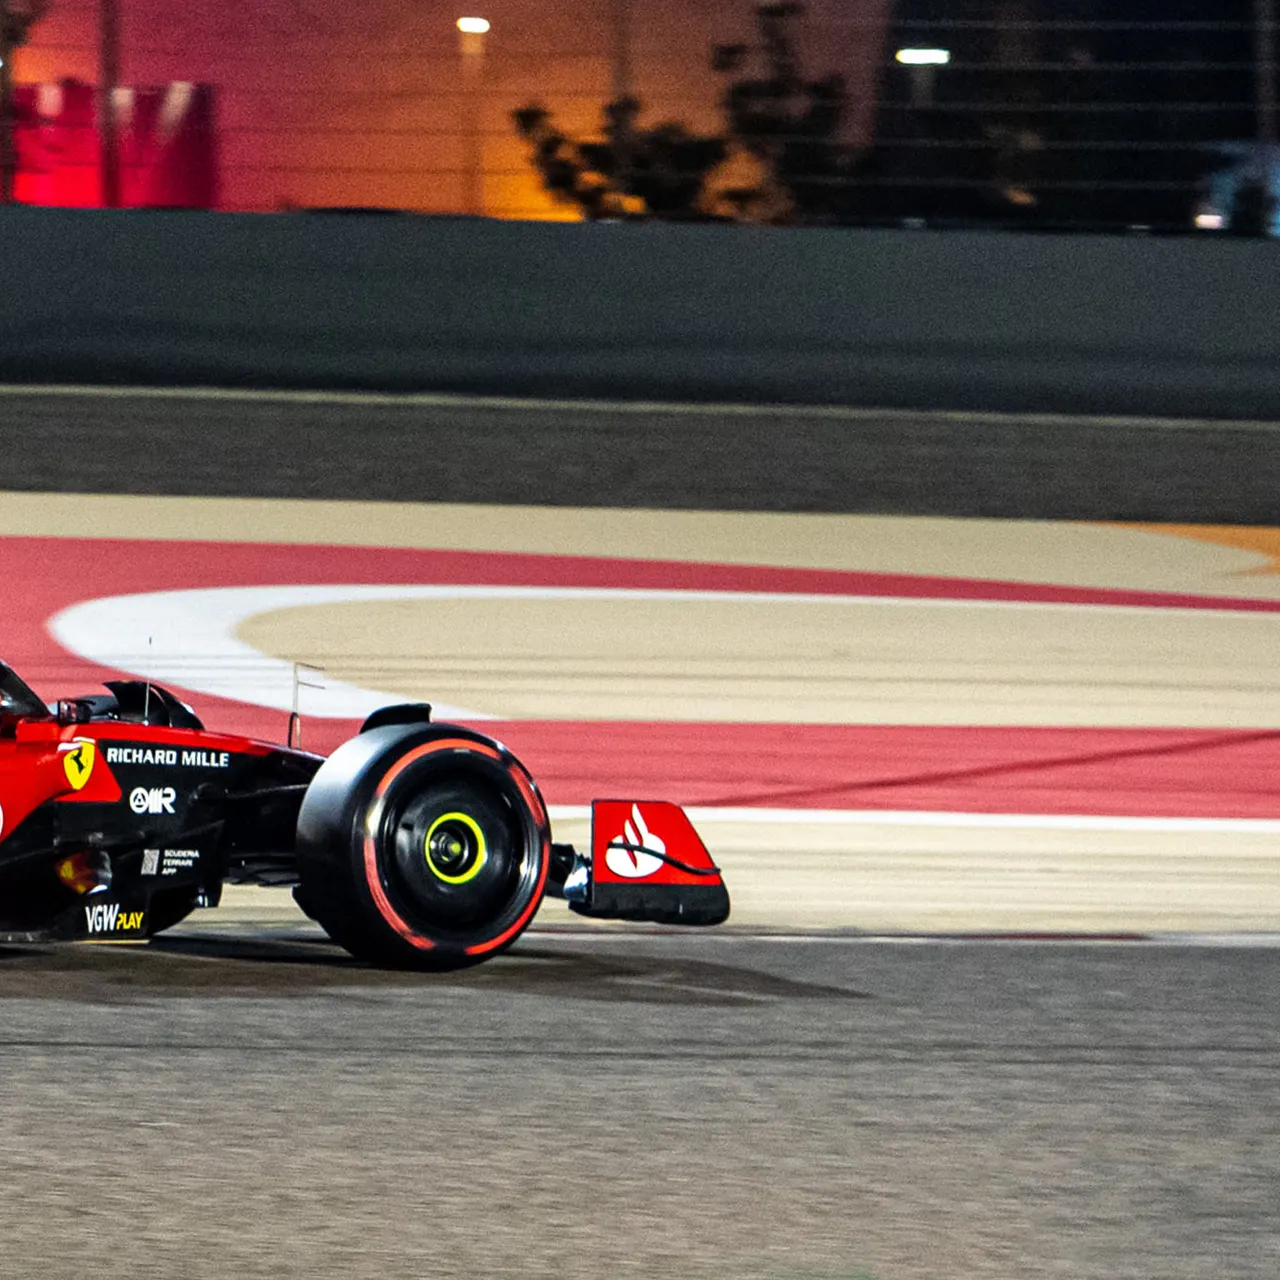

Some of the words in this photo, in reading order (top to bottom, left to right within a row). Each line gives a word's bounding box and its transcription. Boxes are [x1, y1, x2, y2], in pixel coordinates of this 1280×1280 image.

[107, 747, 177, 765] RICHARD
[181, 750, 229, 768] MILLE
[85, 903, 120, 933] VGW
[116, 912, 144, 930] PLAY
